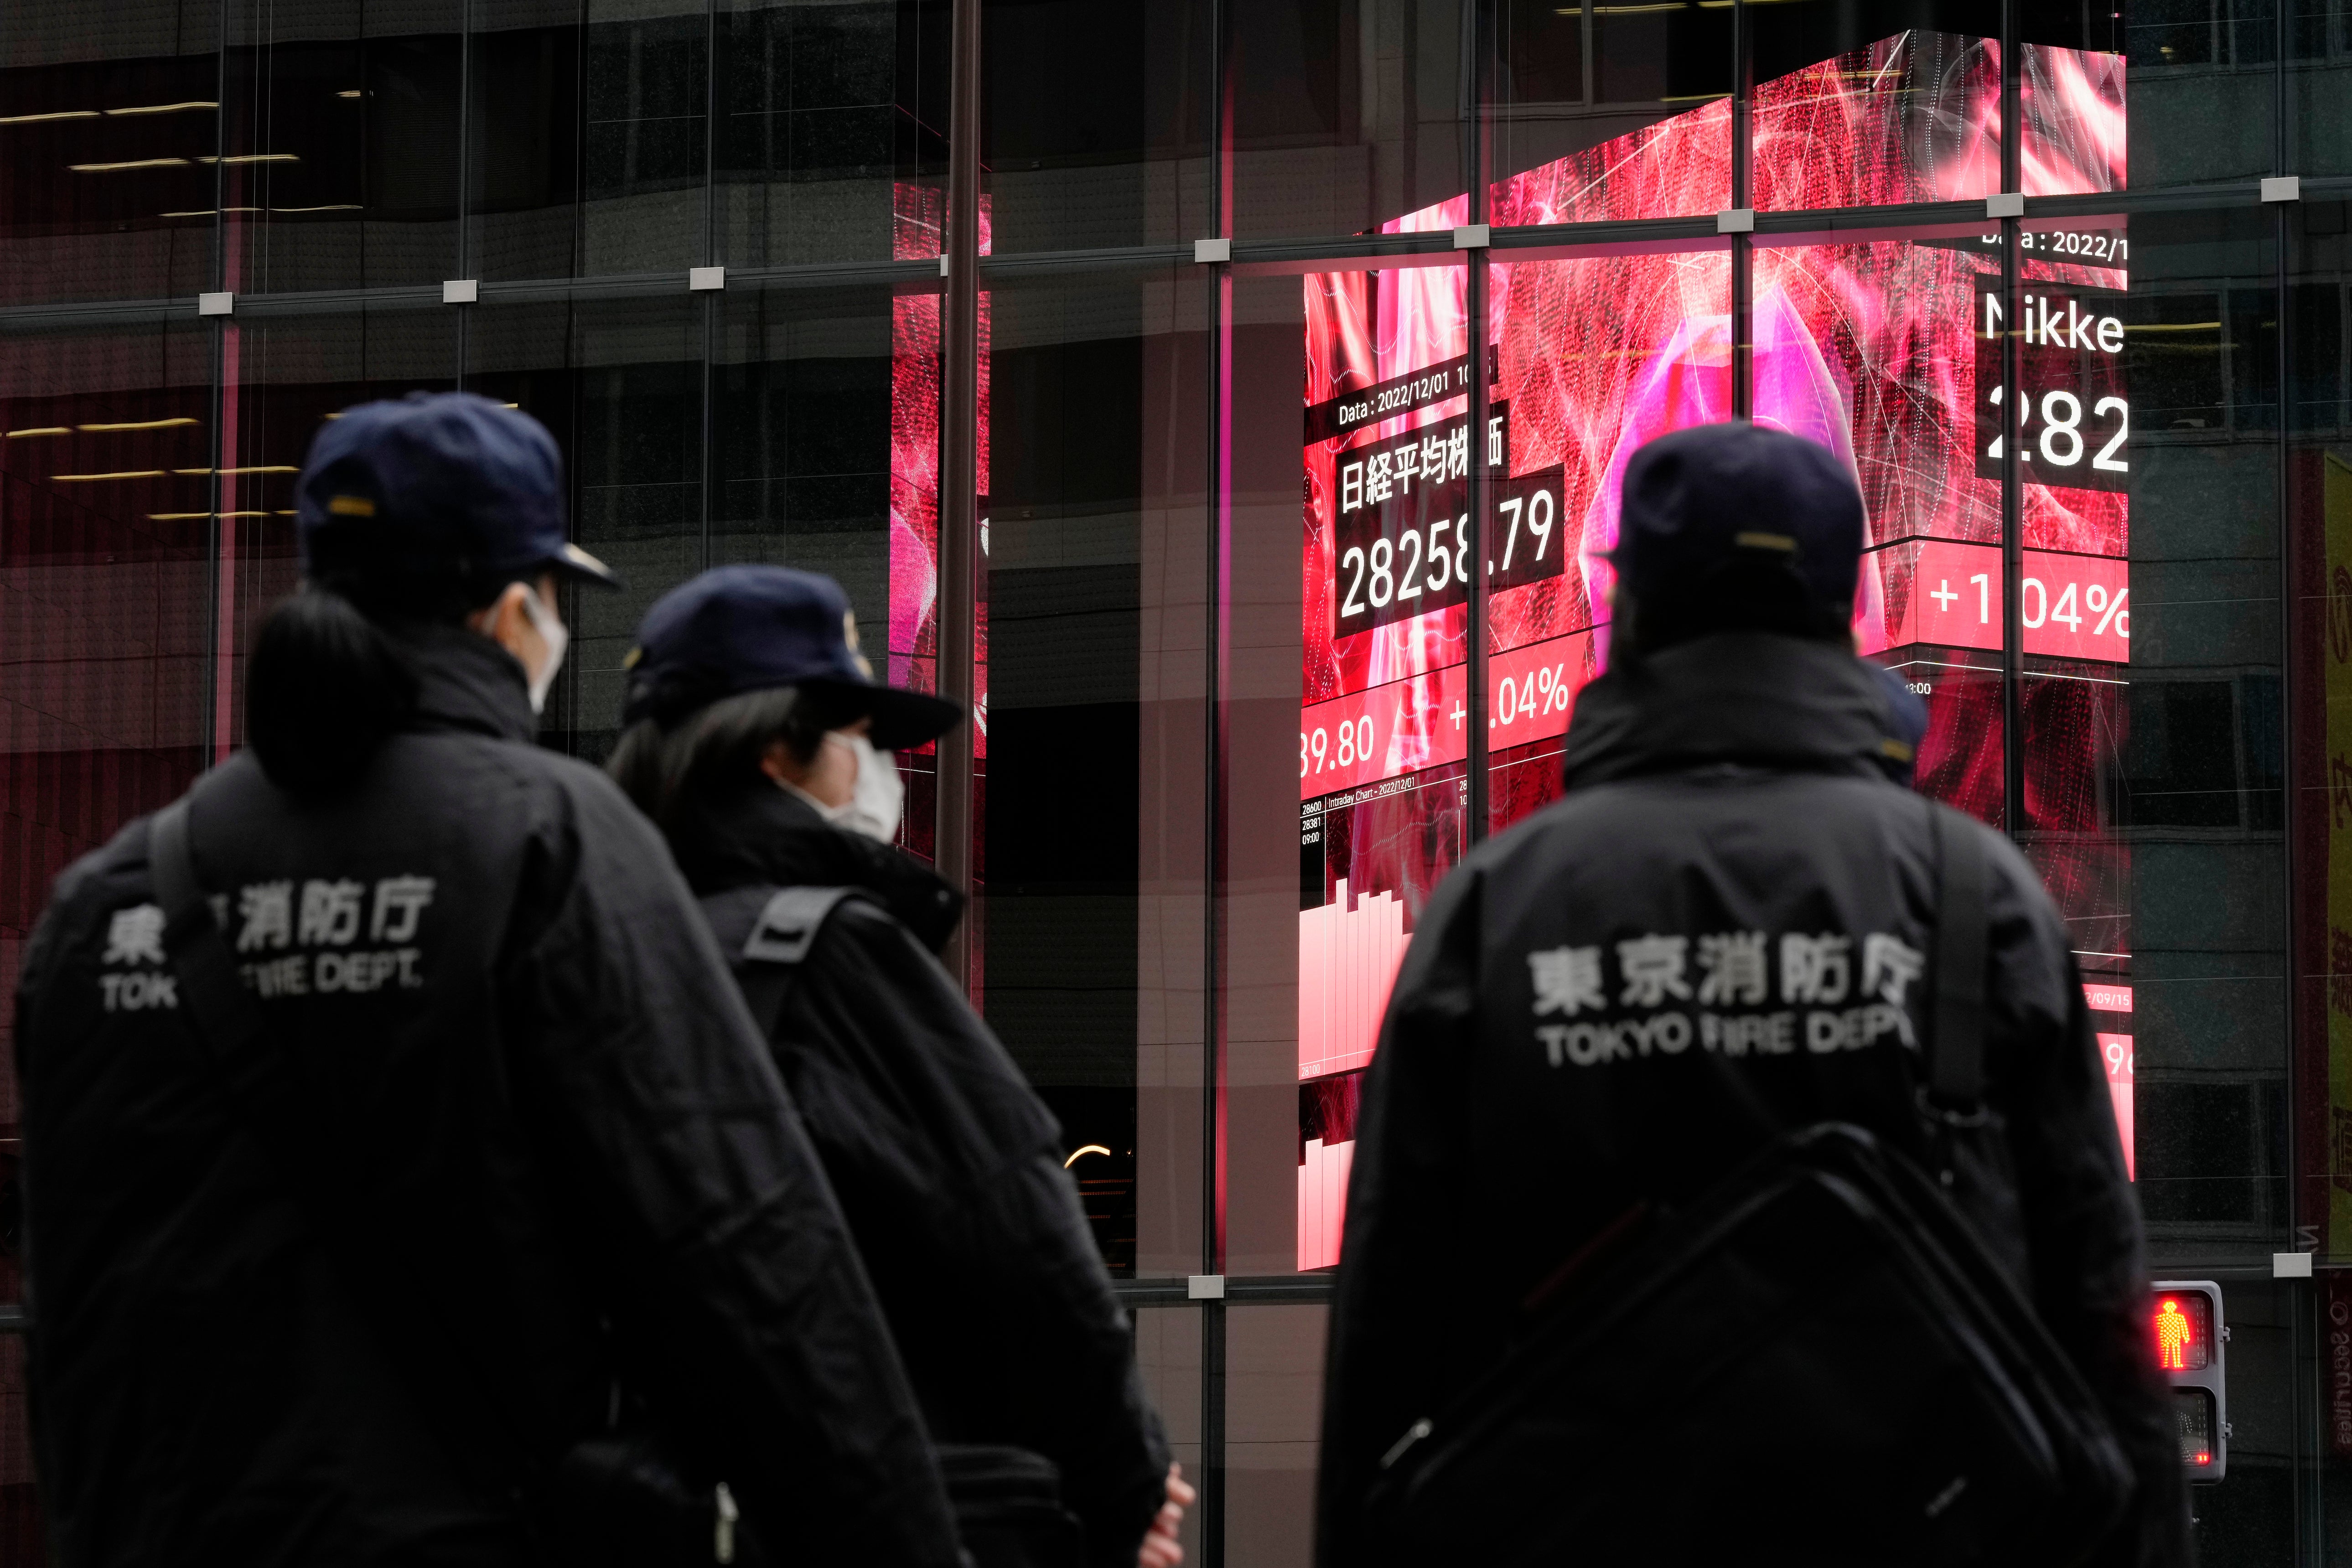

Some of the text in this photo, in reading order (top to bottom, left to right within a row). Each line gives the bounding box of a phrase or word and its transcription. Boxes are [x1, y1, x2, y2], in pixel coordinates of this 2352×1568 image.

[1339, 404, 1368, 425] Data
[1378, 373, 1449, 413] 2022/12/01
[1450, 663, 1568, 730] +.04%
[1302, 801, 1322, 815] 28600
[1328, 792, 1354, 809] Intraday
[1356, 788, 1373, 800] Chart
[1378, 776, 1415, 796] 2022/12/01
[1302, 817, 1321, 831] 28381
[1302, 832, 1320, 845] 09:00
[101, 873, 436, 966] 東消防庁
[97, 971, 178, 1012] TOK
[1534, 1011, 1692, 1067] TOKYO
[1301, 1064, 1320, 1077] 28100
